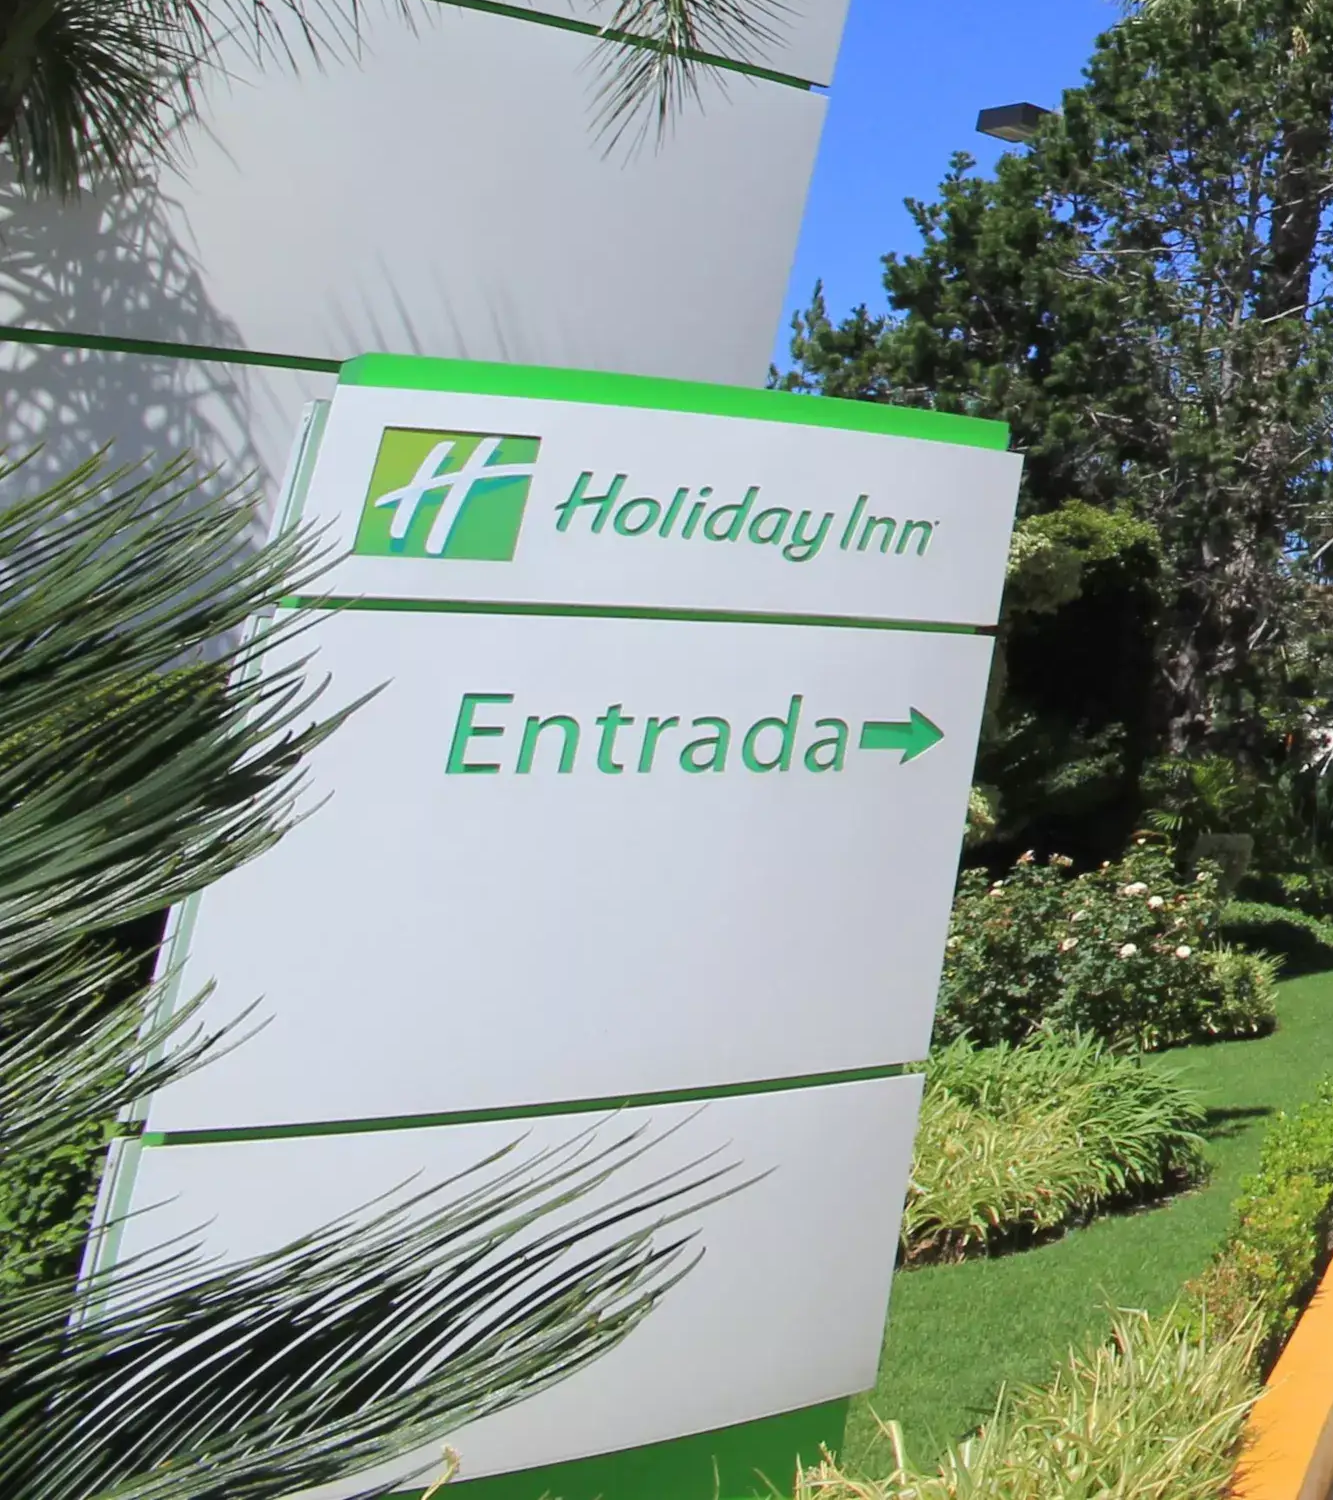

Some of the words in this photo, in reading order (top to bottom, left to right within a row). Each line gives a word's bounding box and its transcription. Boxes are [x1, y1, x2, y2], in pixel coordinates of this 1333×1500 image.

[554, 471, 835, 562] Holiday
[839, 494, 938, 556] Inn
[445, 692, 850, 775] Entrada
